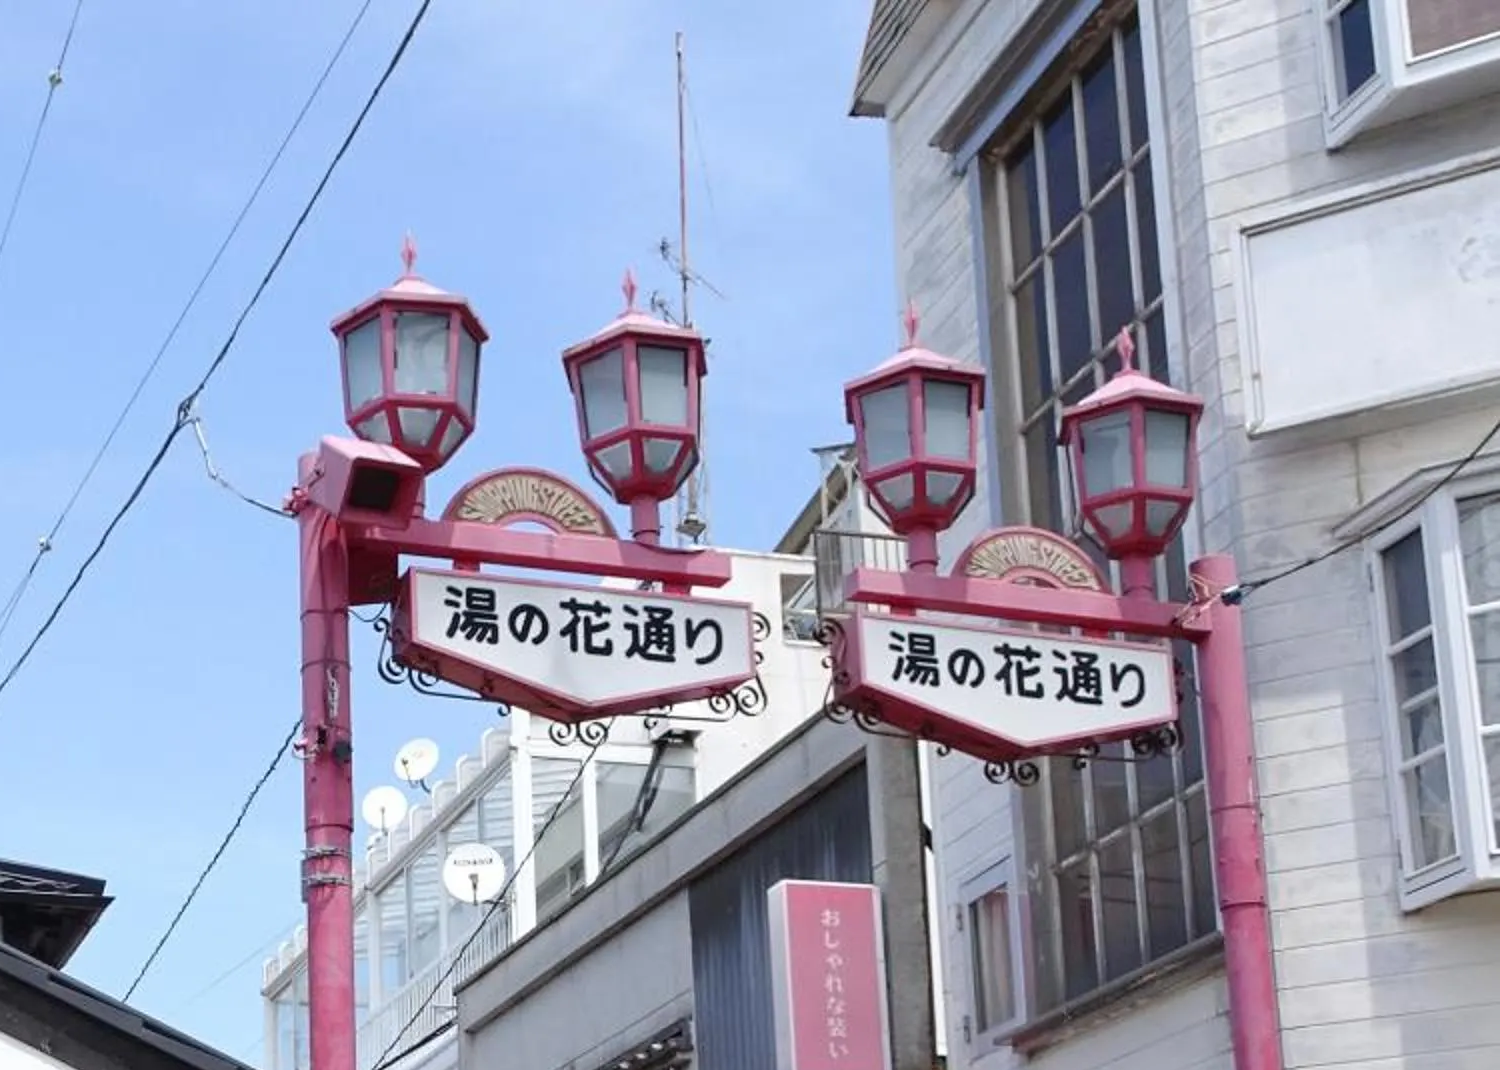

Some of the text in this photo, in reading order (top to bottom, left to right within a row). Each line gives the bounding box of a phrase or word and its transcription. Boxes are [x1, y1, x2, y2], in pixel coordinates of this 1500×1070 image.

[443, 586, 724, 665] 湯の花通り
[889, 632, 1146, 709] 湯の花通り
[820, 908, 848, 1060] おしゃれな装い
